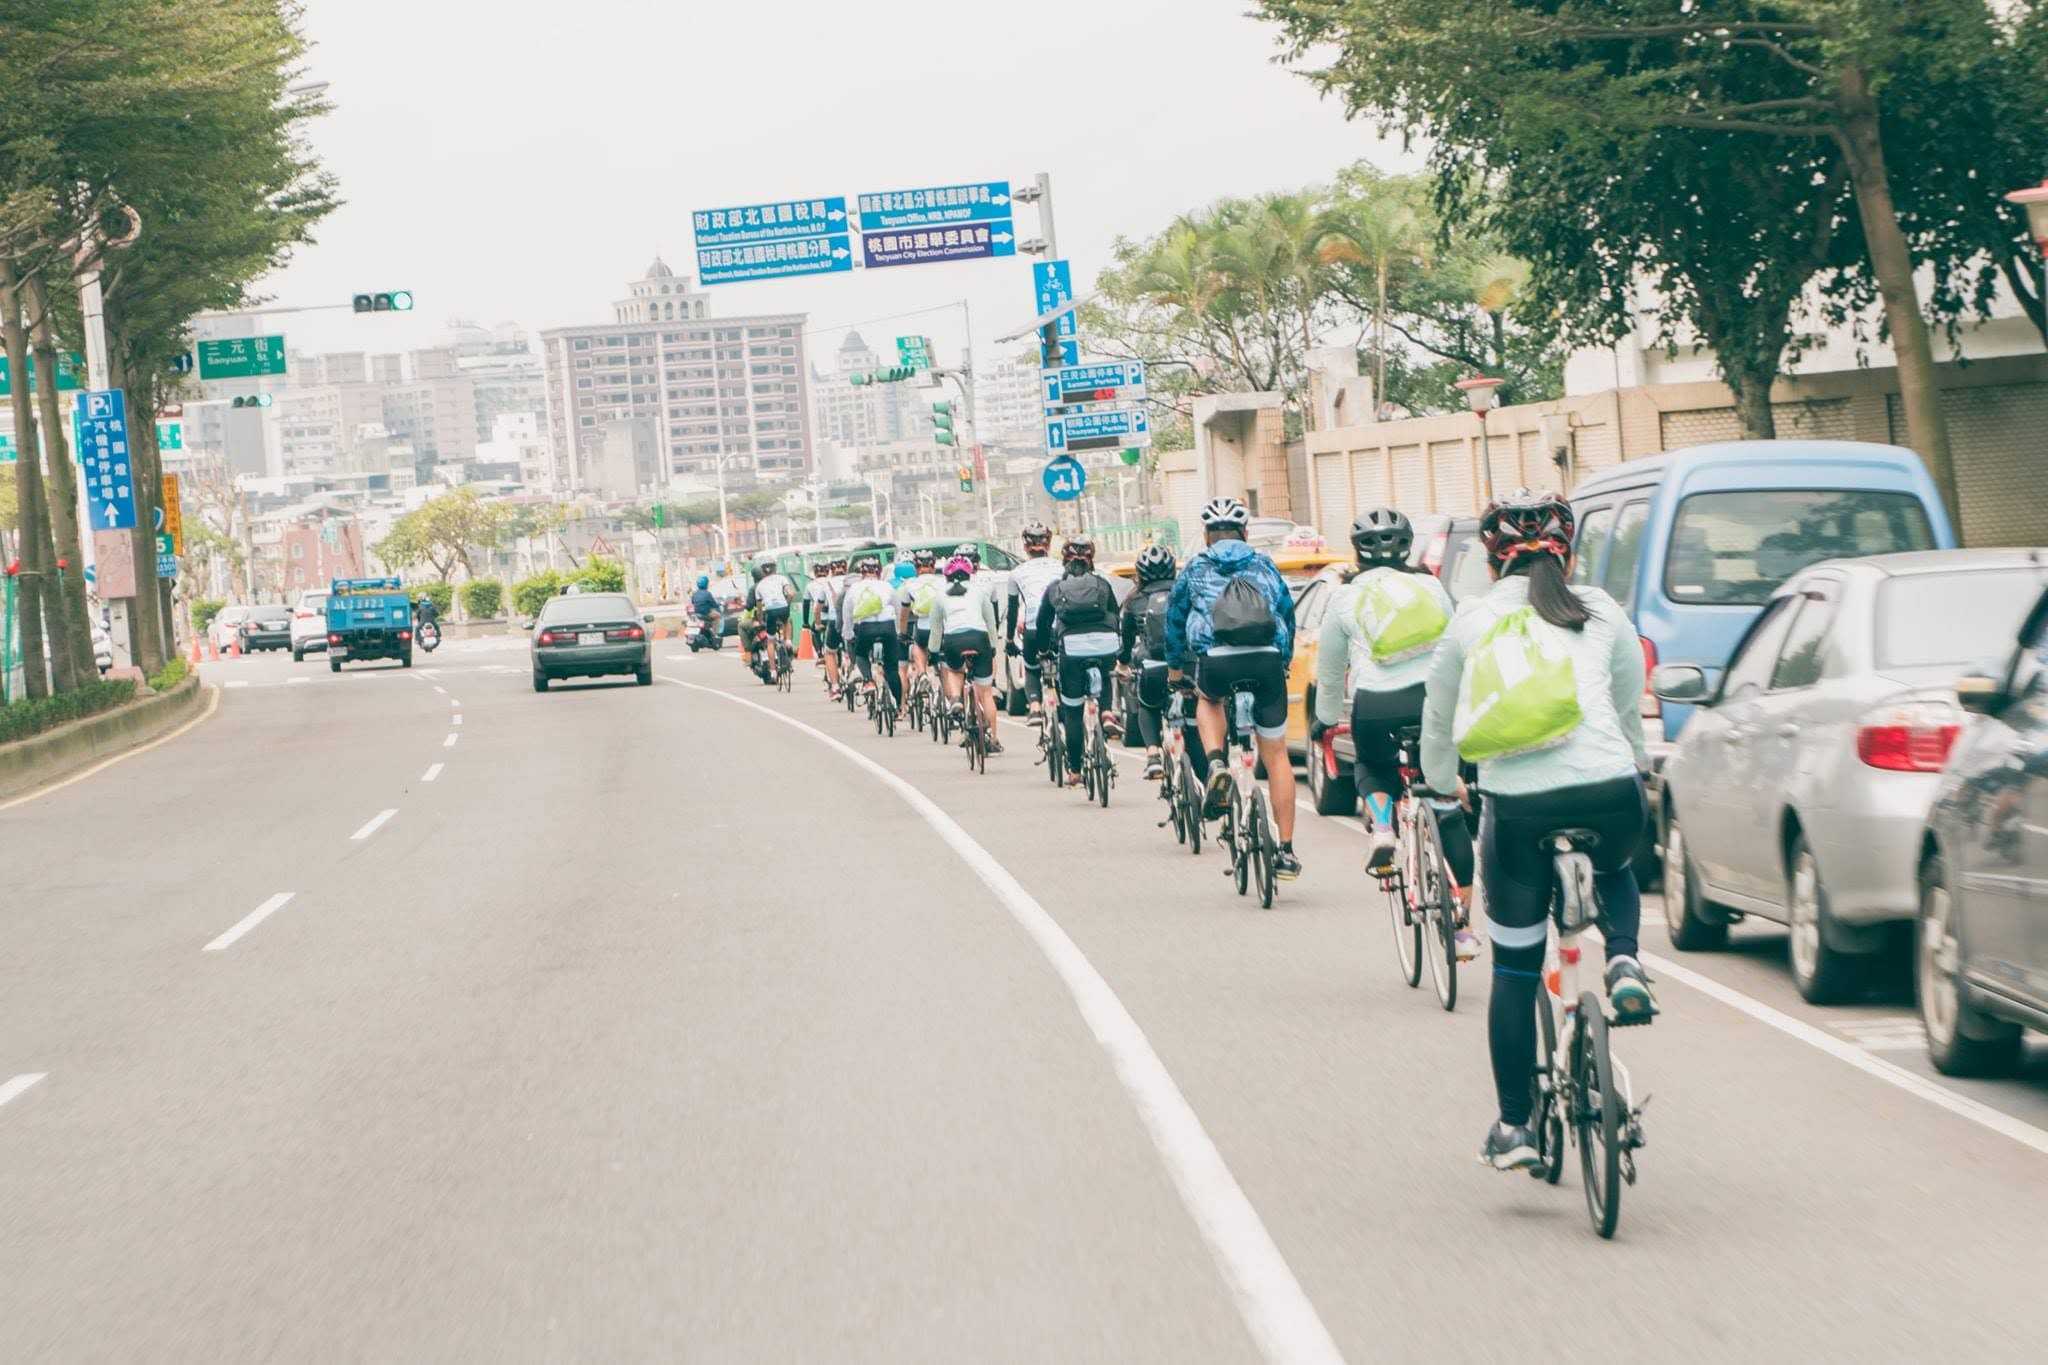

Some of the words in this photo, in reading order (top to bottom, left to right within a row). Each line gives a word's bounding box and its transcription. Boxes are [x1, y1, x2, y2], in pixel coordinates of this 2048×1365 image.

[694, 201, 826, 230] 財政部北區國稅局
[880, 213, 907, 225] Taoyuan
[906, 211, 927, 223] Office,
[867, 228, 989, 253] 桃園市選舉委員會
[698, 240, 830, 268] 財政部北區國稅局桃園分局
[875, 252, 902, 262] Taoyuan
[902, 251, 916, 259] City
[917, 249, 943, 257] Election
[944, 245, 985, 254] Commission
[207, 338, 268, 356] 三元街
[207, 356, 248, 366] Sanyuan
[1061, 365, 1122, 380] 三民公園停車場
[1094, 376, 1120, 386] Parking
[1066, 413, 1128, 428] 朝陽公園停車場
[1101, 423, 1128, 433] Parking
[95, 421, 114, 499] 汽機車停車場
